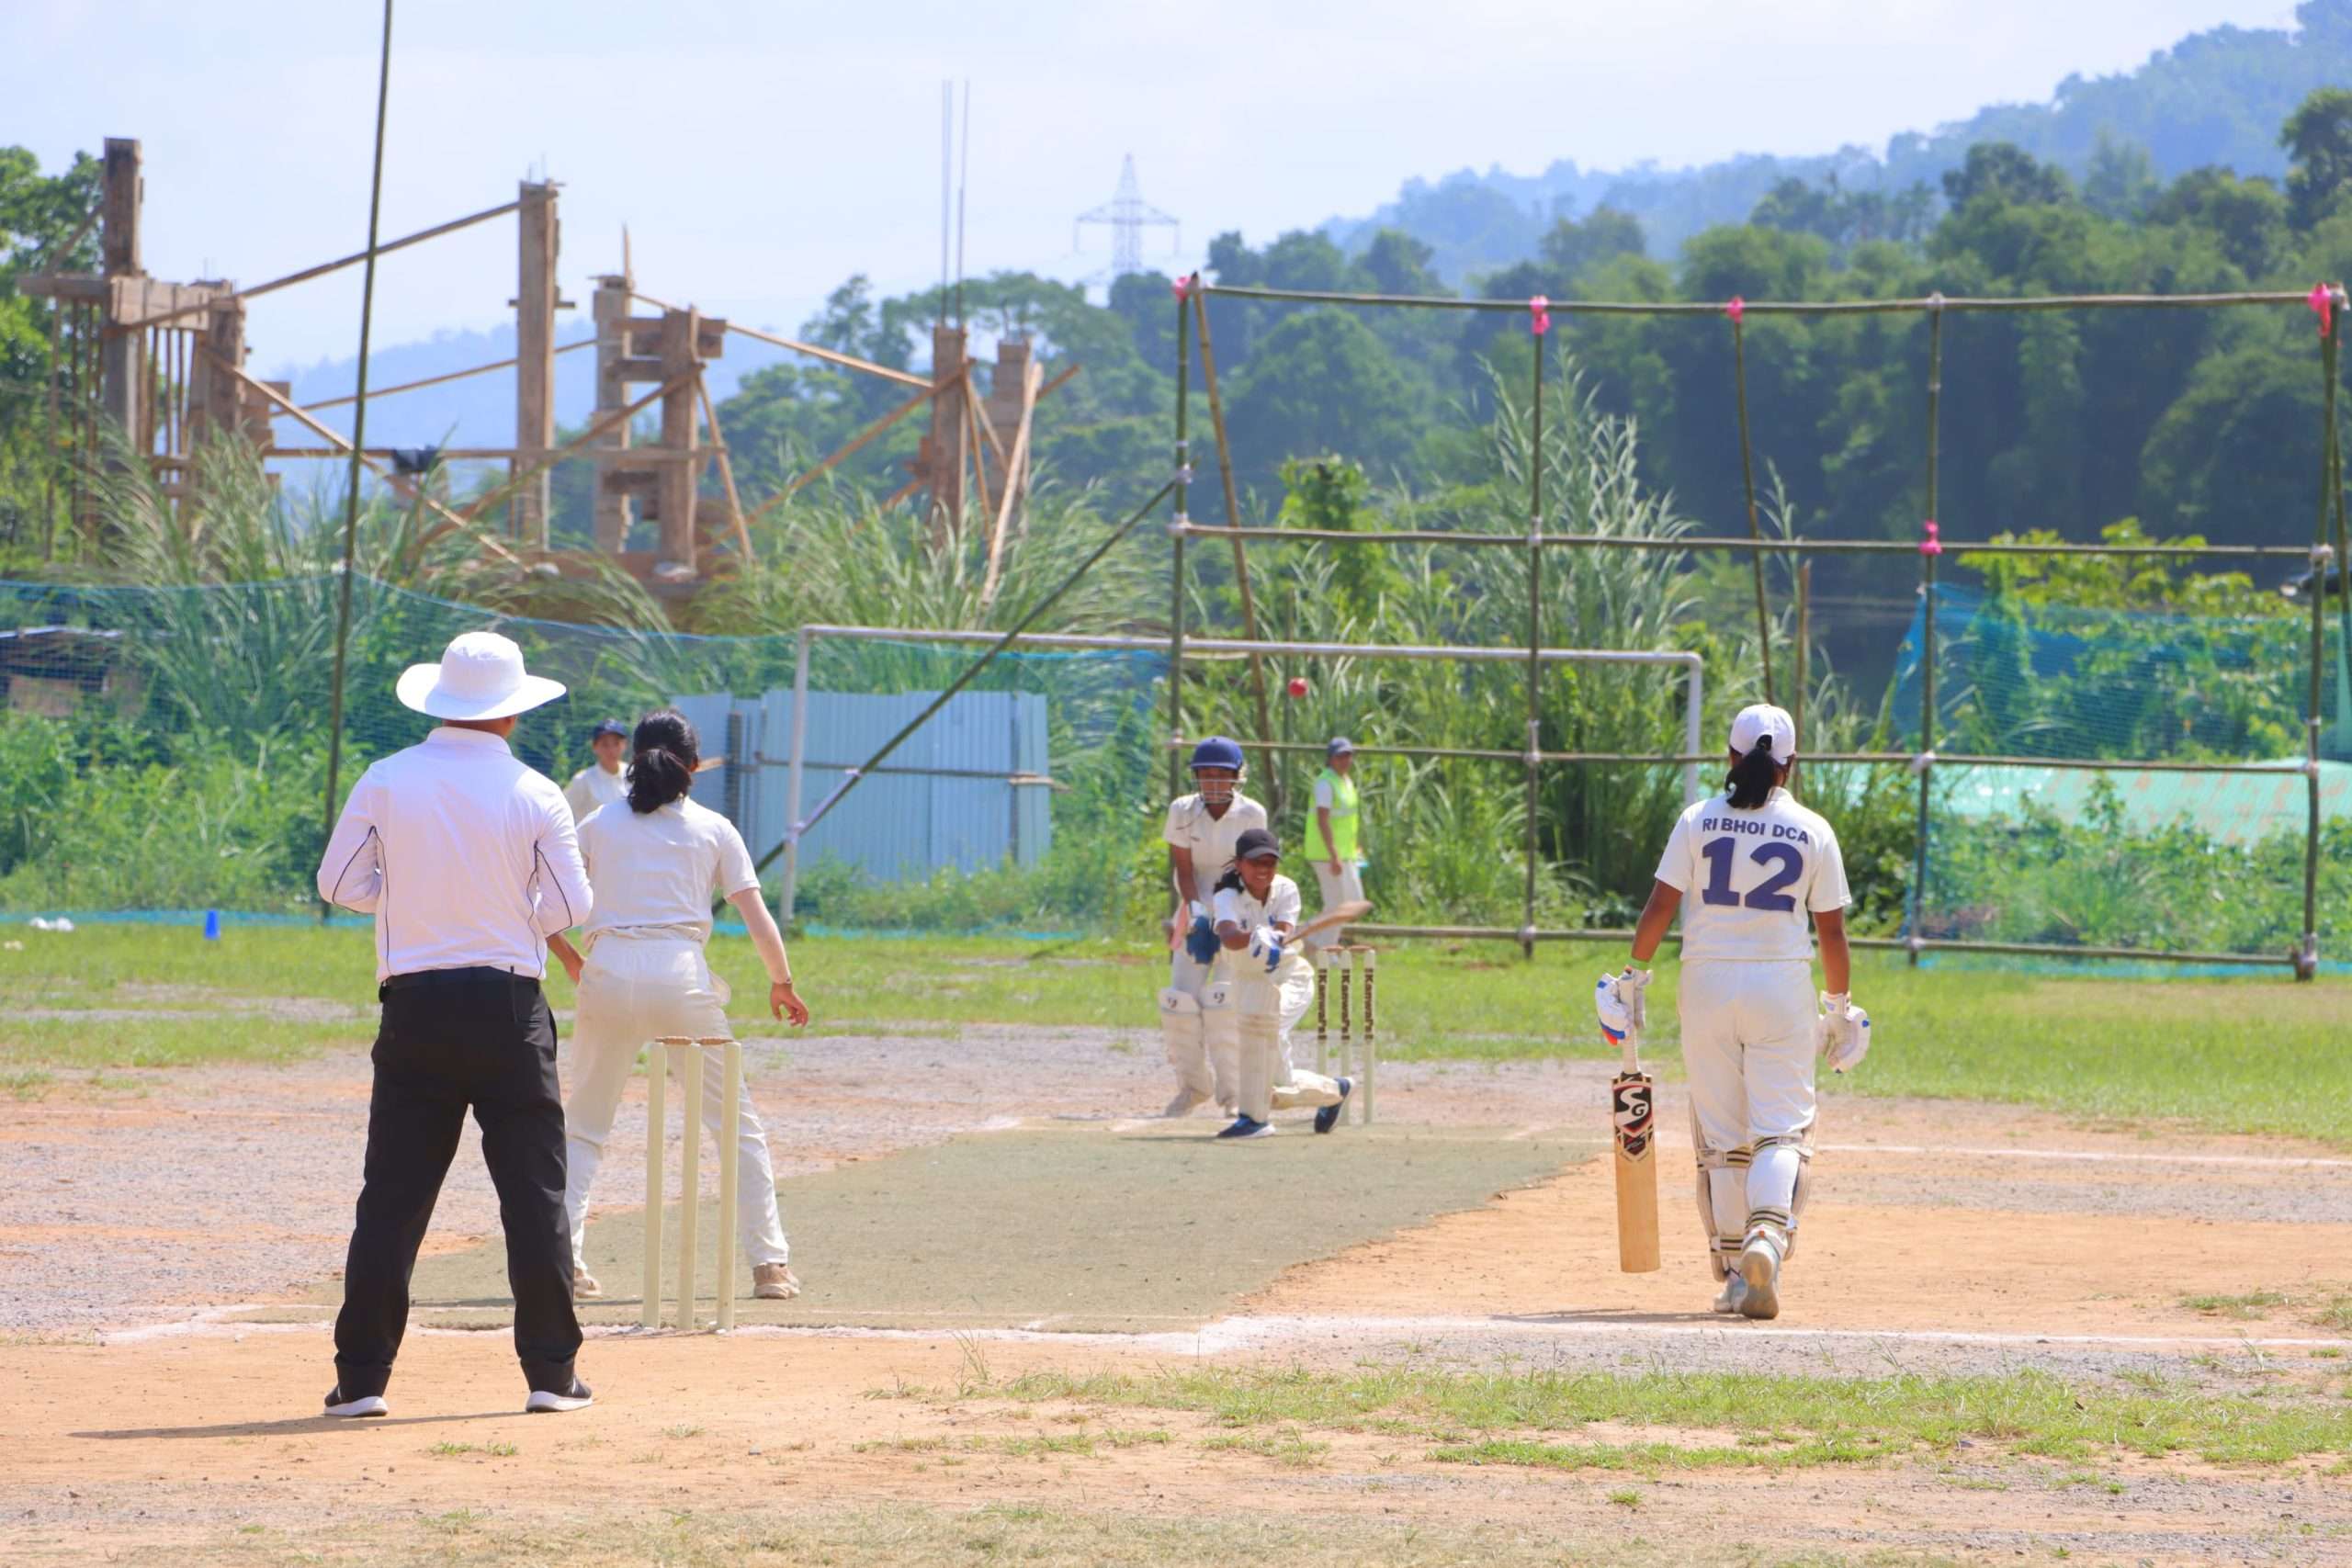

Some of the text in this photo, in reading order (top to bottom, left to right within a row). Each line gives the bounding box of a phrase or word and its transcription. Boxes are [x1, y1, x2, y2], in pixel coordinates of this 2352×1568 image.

[1702, 818, 1809, 844] RI BHOI DCA
[1702, 836, 1804, 912] 12
[1614, 1087, 1650, 1127] SG
